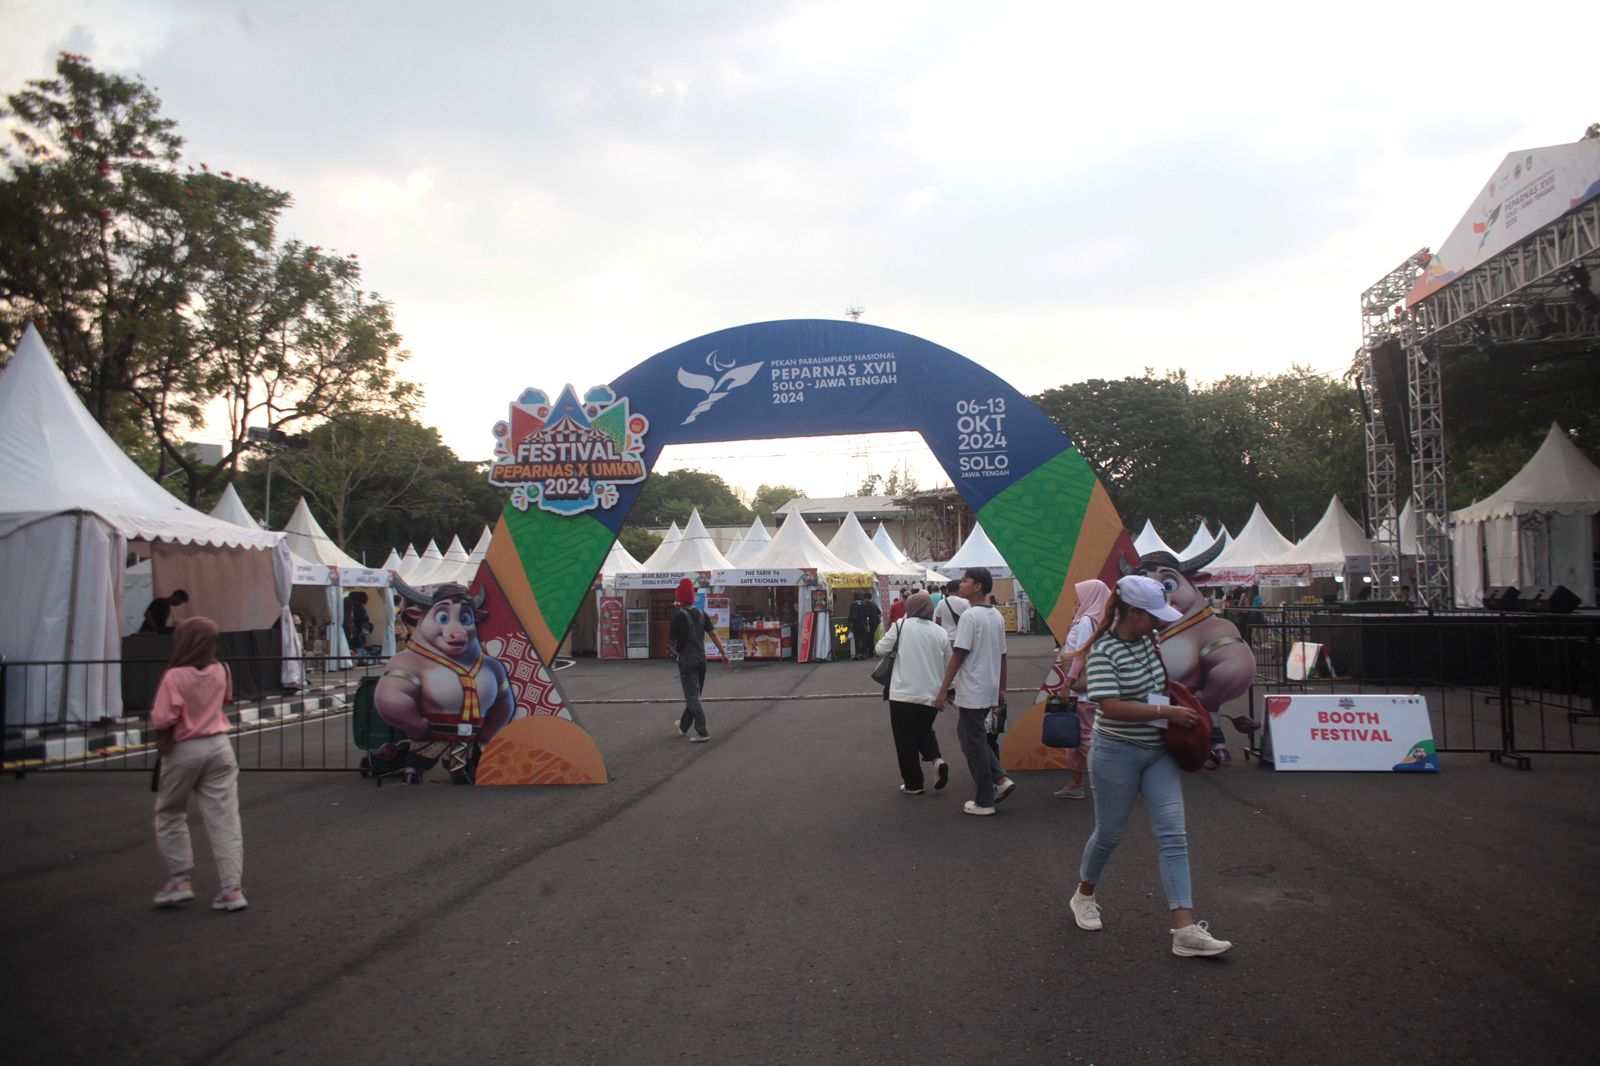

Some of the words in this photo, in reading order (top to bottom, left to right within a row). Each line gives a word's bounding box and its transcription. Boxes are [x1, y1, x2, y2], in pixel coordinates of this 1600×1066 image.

[799, 355, 853, 365] PARALIMPIADE
[854, 352, 896, 361] NASIONAL
[771, 363, 857, 381] PEPARNAS
[863, 361, 897, 375] XVII
[772, 381, 805, 392] SOLO
[814, 378, 846, 389] JAWA
[848, 375, 897, 386] TENGAH
[772, 391, 804, 404] 2024
[956, 397, 1006, 415] 06-13
[957, 413, 1006, 434] OKT
[958, 432, 1008, 450] 2024
[517, 440, 622, 463] FESTIVAL
[959, 454, 1009, 471] SOLO
[493, 464, 574, 481] PEPARNAS
[578, 463, 589, 477] X
[591, 462, 642, 476] UMKM
[961, 471, 980, 479] JAWA
[981, 469, 1010, 477] TENGAH
[544, 478, 591, 495] 2024
[1317, 711, 1380, 725] BOOTH
[1310, 728, 1392, 742] FESTIVAL
